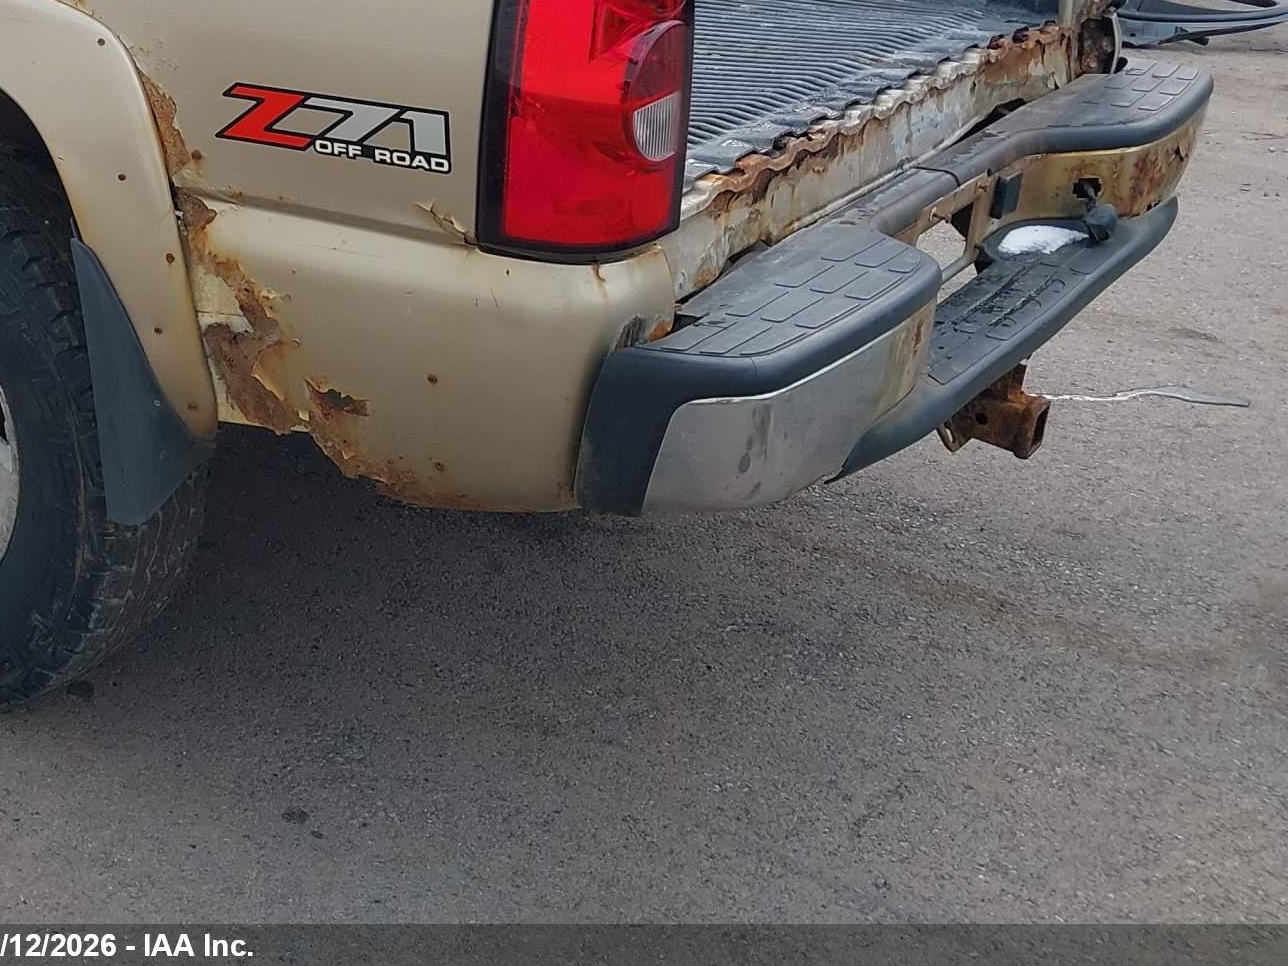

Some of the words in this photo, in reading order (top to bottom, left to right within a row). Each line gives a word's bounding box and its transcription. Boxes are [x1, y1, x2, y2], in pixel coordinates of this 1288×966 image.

[215, 82, 450, 157] Z71
[314, 140, 363, 158] OFF
[374, 149, 450, 173] ROAD
